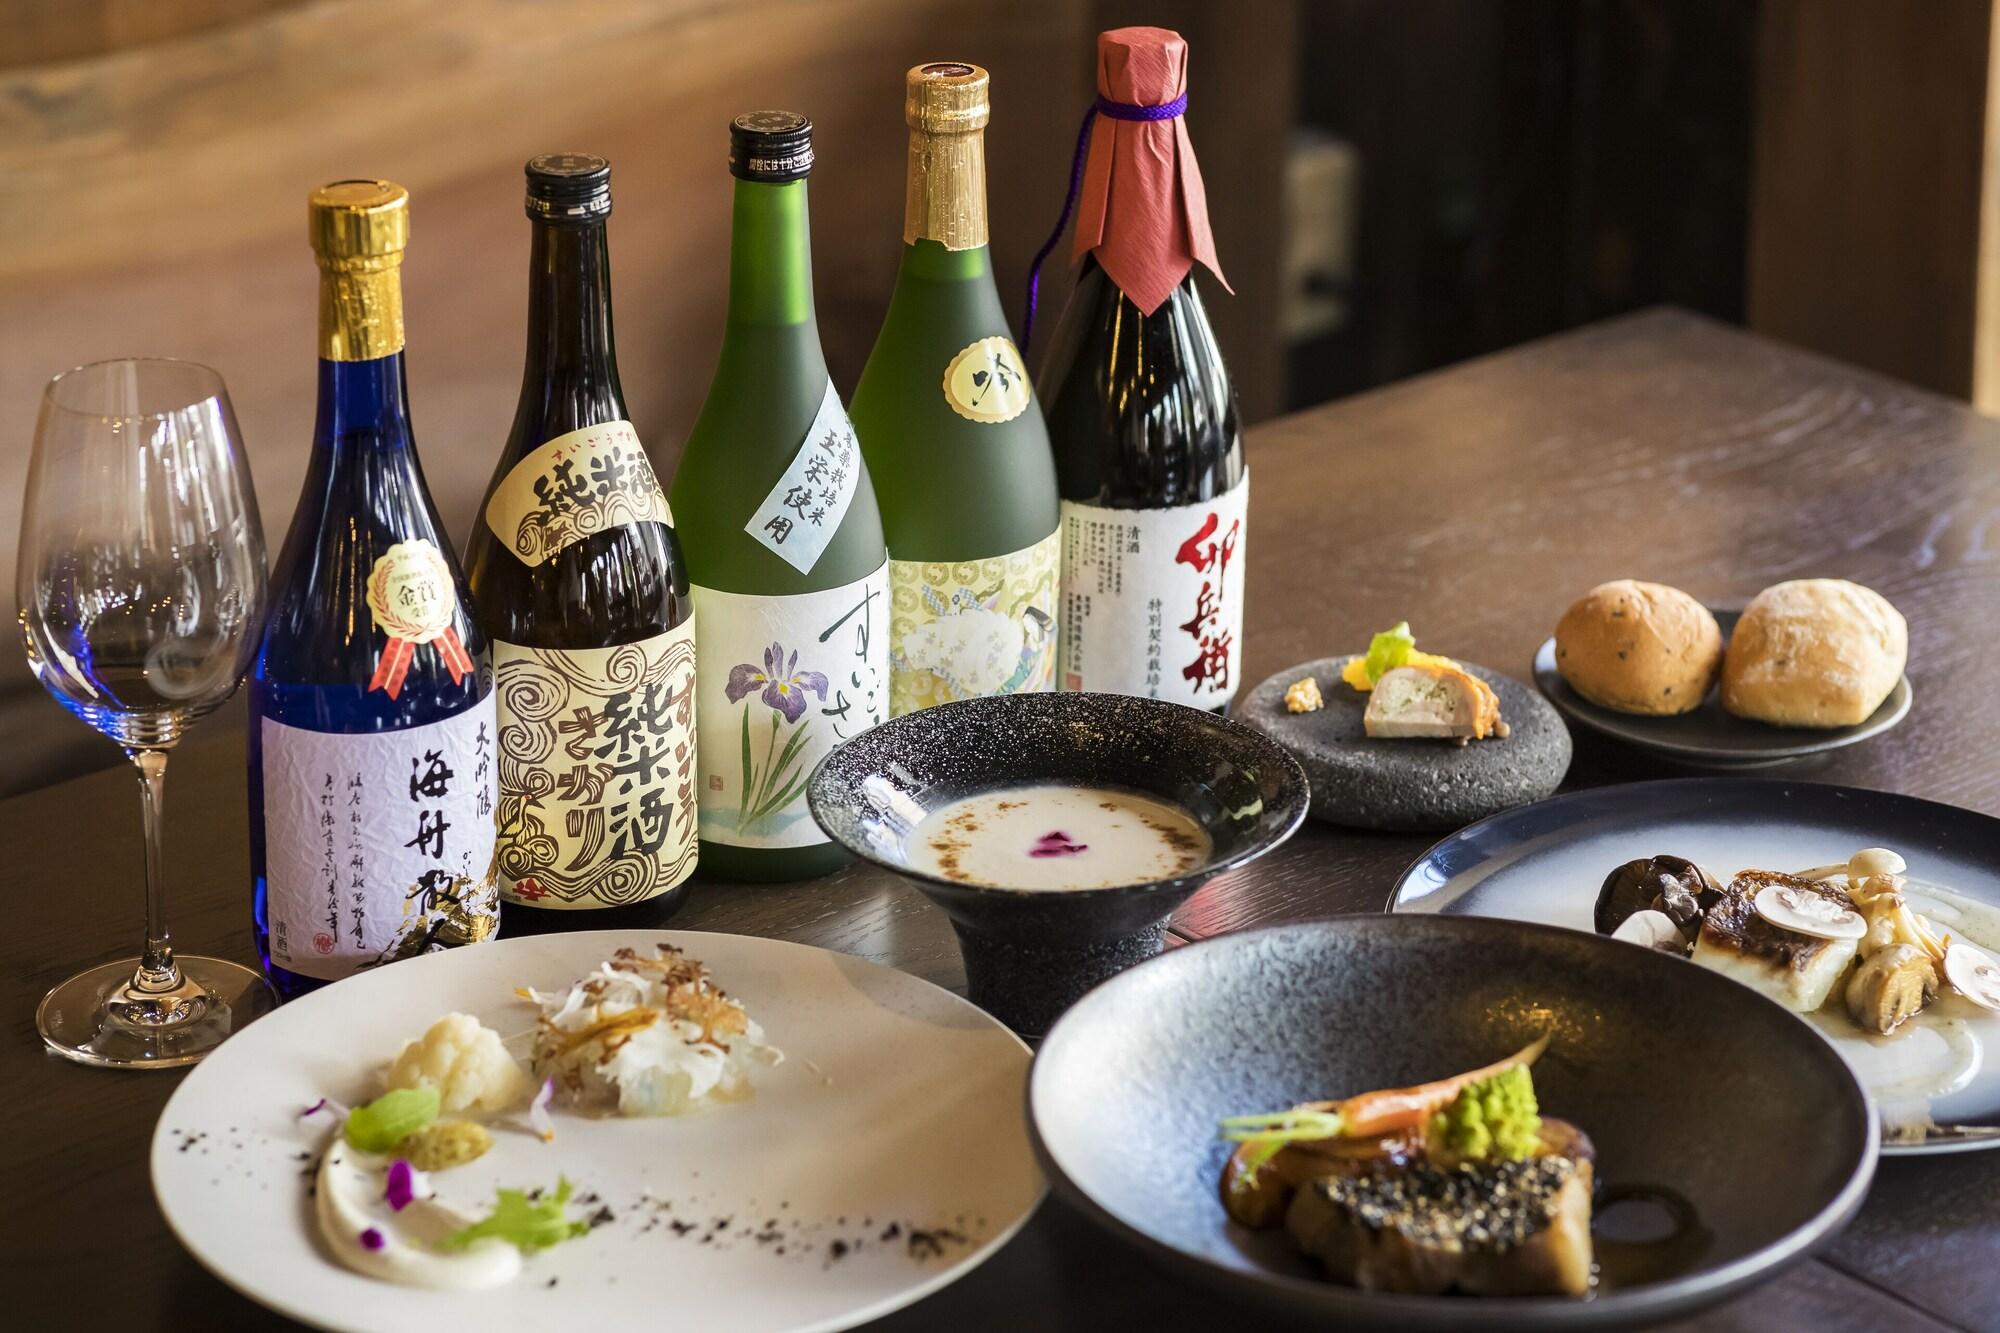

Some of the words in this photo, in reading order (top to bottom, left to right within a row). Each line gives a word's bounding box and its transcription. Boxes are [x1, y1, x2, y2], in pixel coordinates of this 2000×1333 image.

[533, 446, 656, 527] 純米酒
[1126, 525, 1142, 554] 清酒
[594, 683, 673, 860] 純米酒
